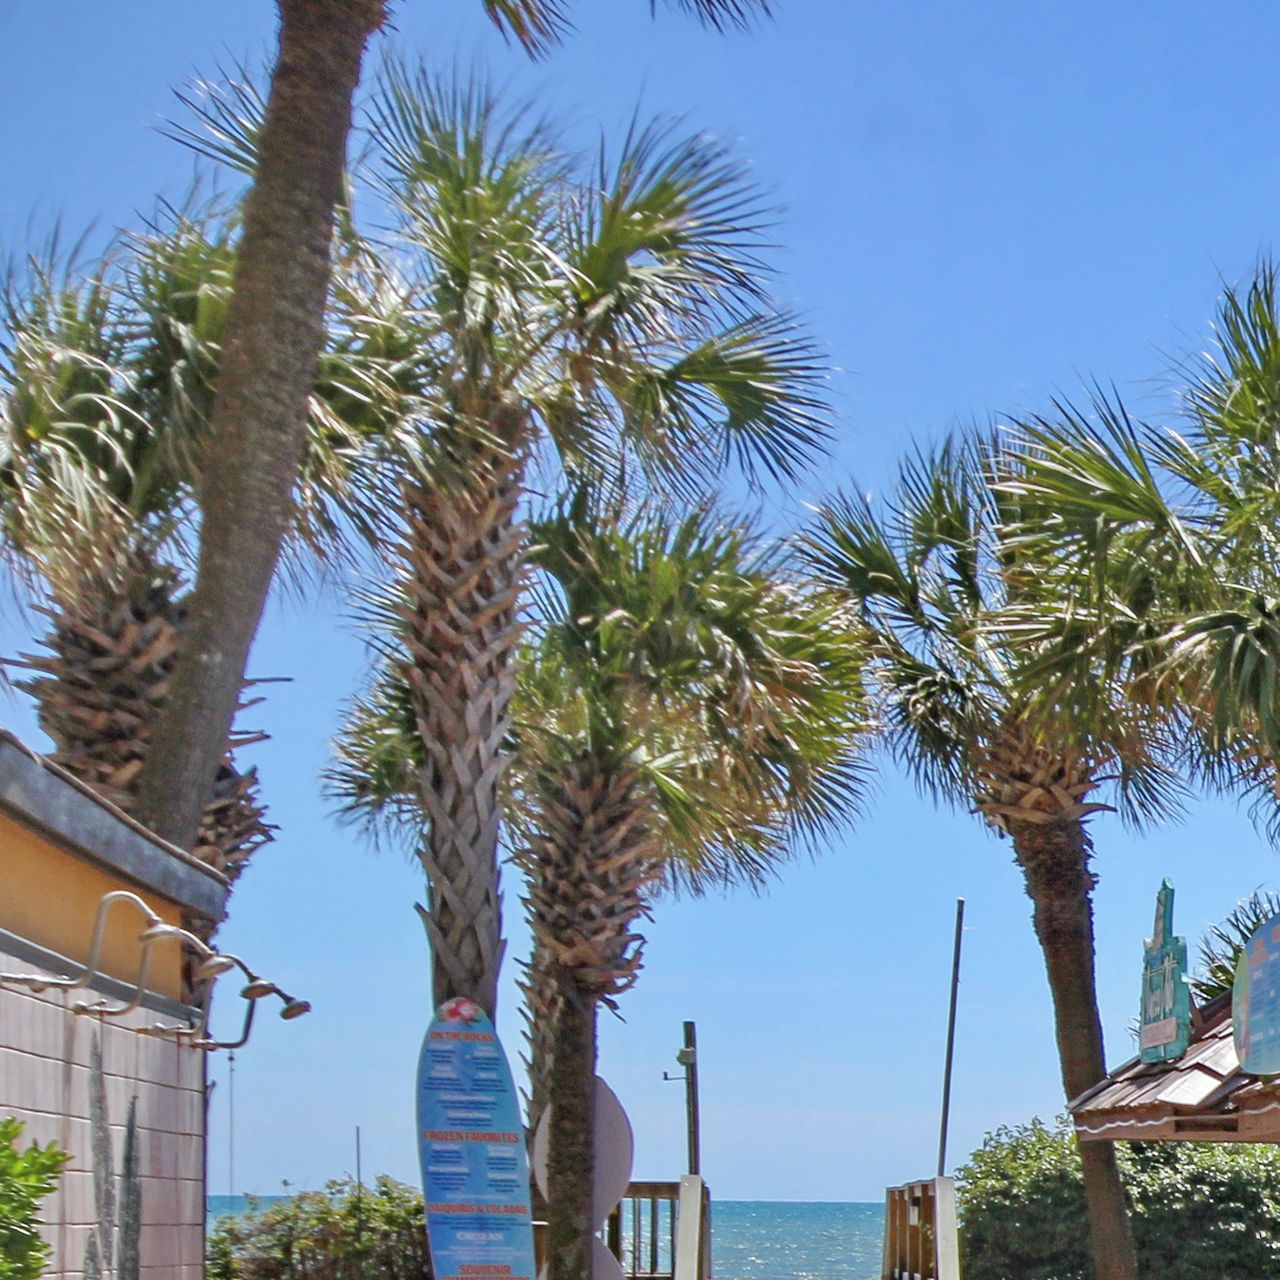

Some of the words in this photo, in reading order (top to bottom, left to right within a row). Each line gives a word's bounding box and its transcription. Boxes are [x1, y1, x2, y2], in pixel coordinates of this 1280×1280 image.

[424, 1130, 465, 1142] FROZEN
[465, 1131, 520, 1143] FAVORITES
[486, 1204, 528, 1214] COLADAS
[460, 1263, 512, 1275] SOUVENIR
